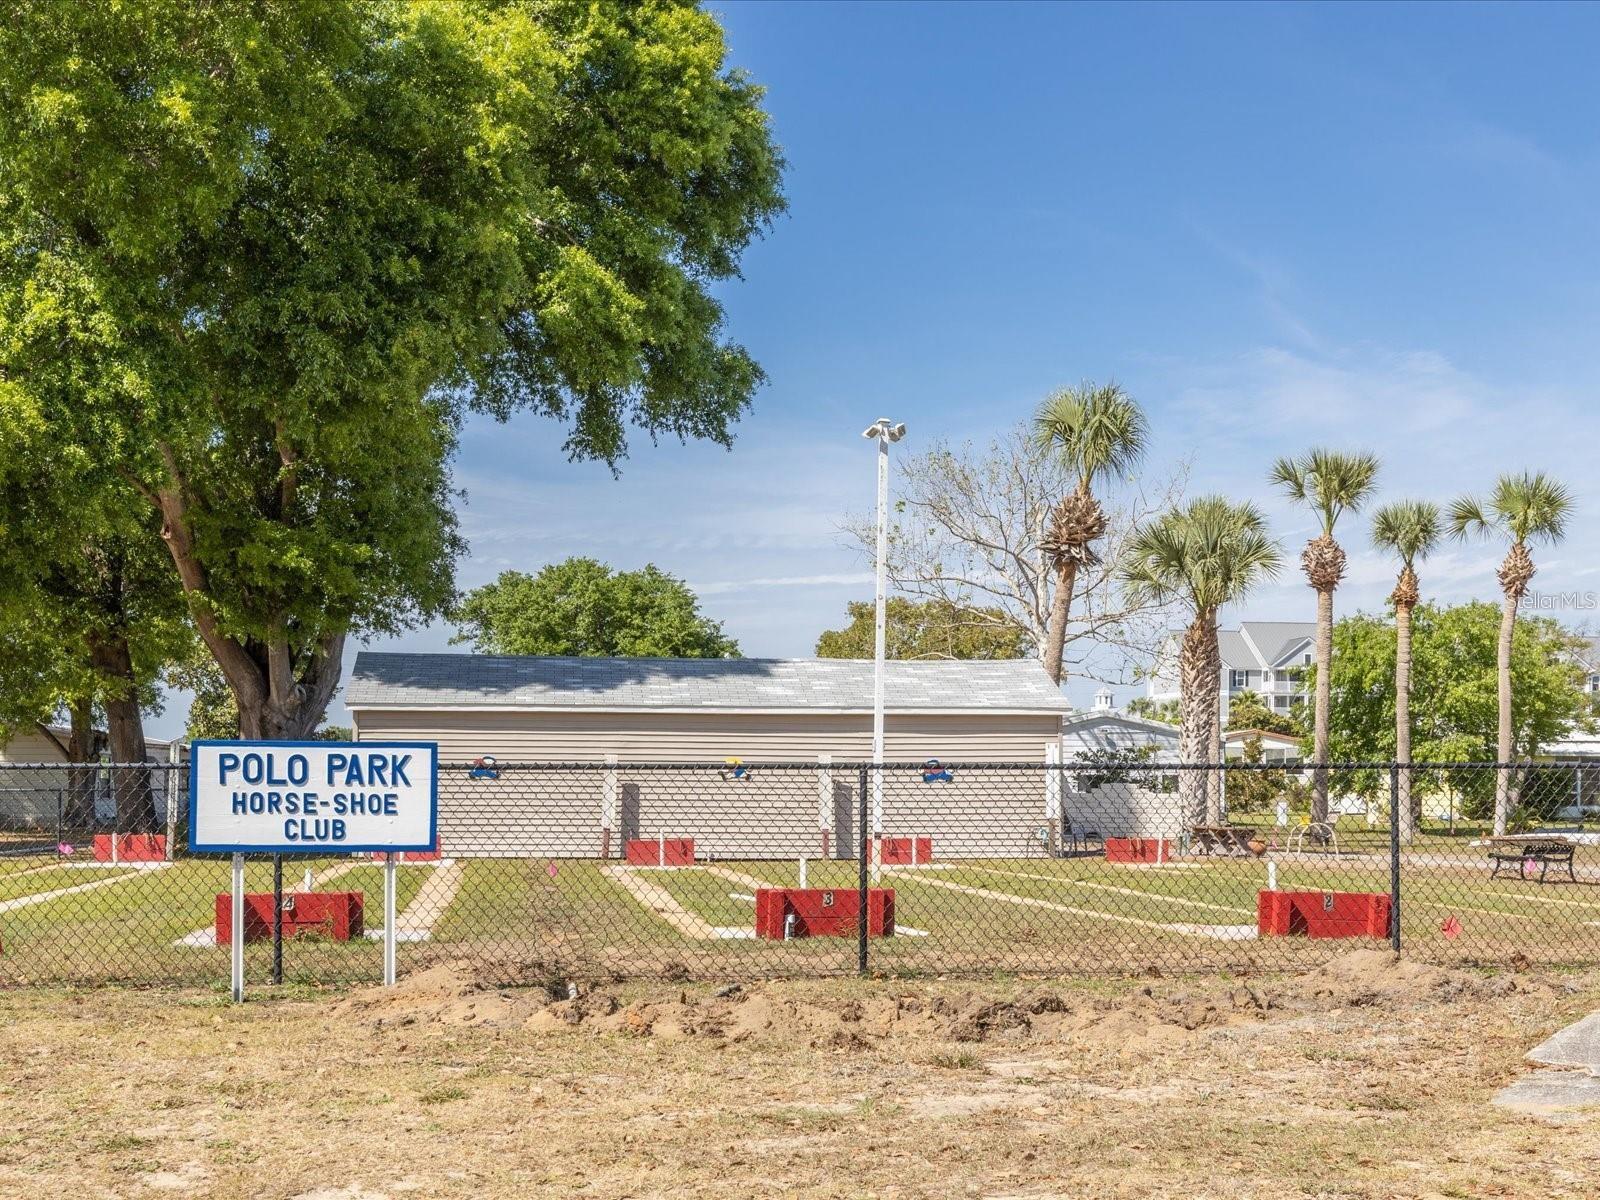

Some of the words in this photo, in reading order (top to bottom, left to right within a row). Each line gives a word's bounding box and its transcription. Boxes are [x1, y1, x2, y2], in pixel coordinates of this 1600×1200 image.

[219, 753, 309, 787] POLO
[327, 753, 412, 787] PARK
[232, 791, 399, 815] HORSE-SHOE
[284, 818, 347, 841] CLUB
